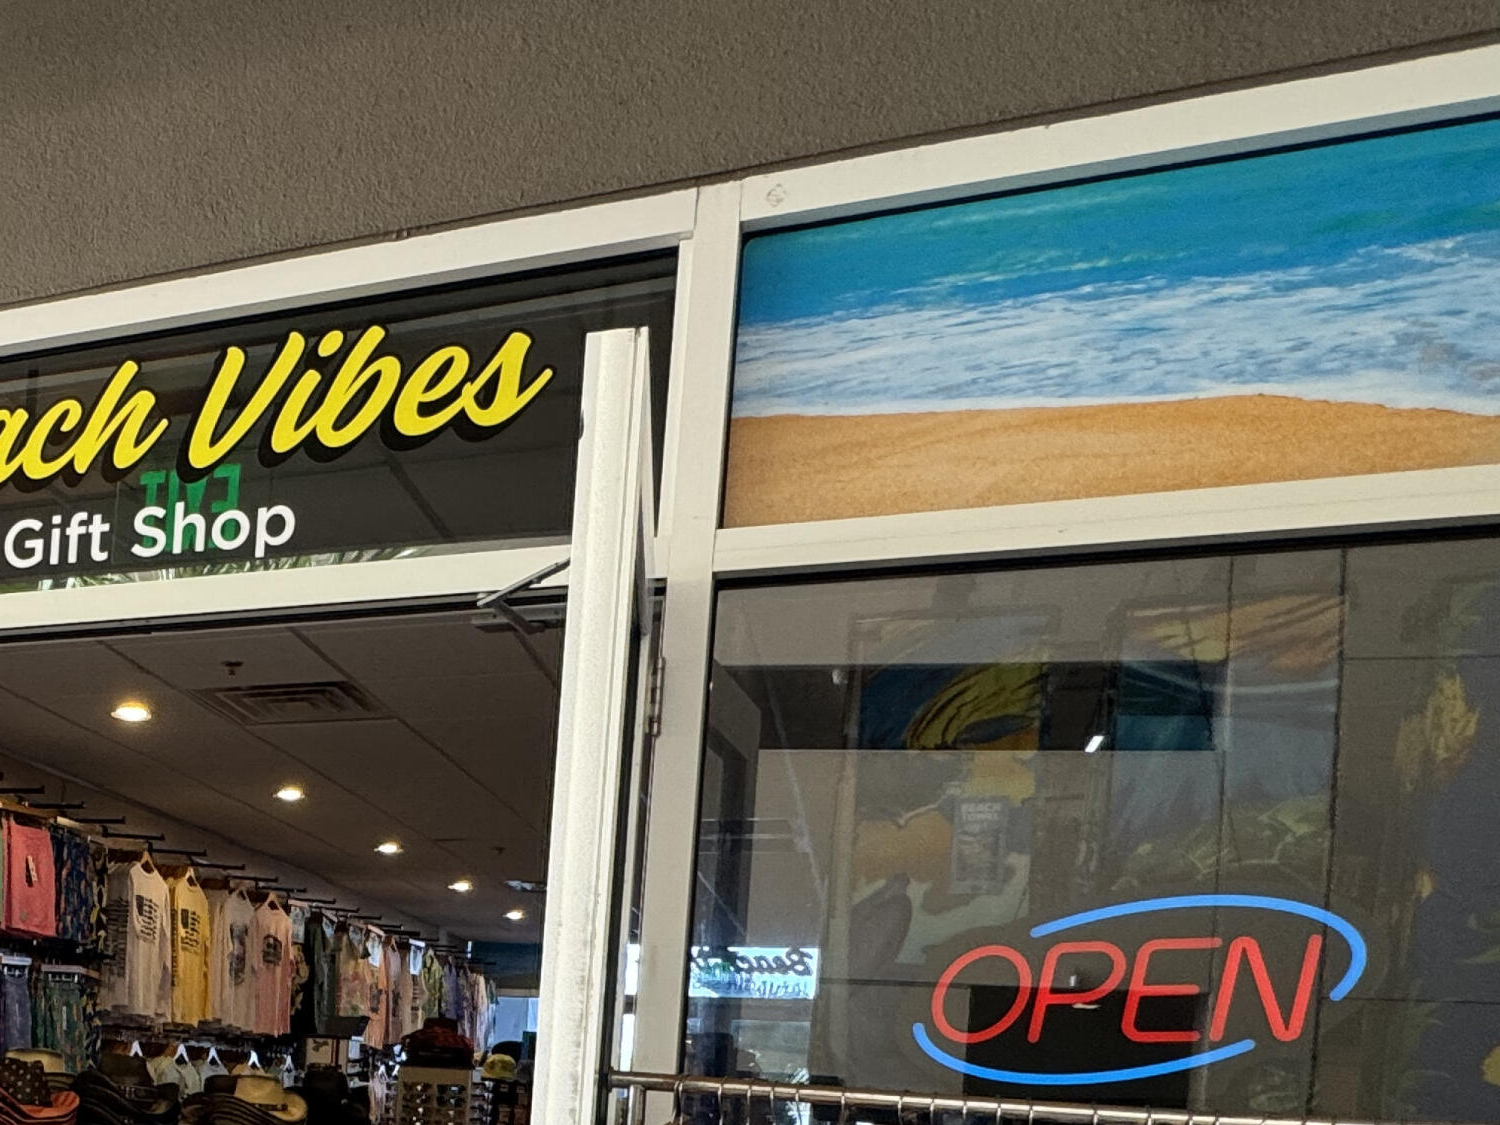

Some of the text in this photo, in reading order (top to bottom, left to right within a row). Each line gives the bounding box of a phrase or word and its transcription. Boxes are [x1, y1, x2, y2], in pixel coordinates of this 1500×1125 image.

[187, 325, 554, 470] Vibes
[3, 500, 296, 569] Gift Shop
[931, 934, 1323, 1044] OPEN
